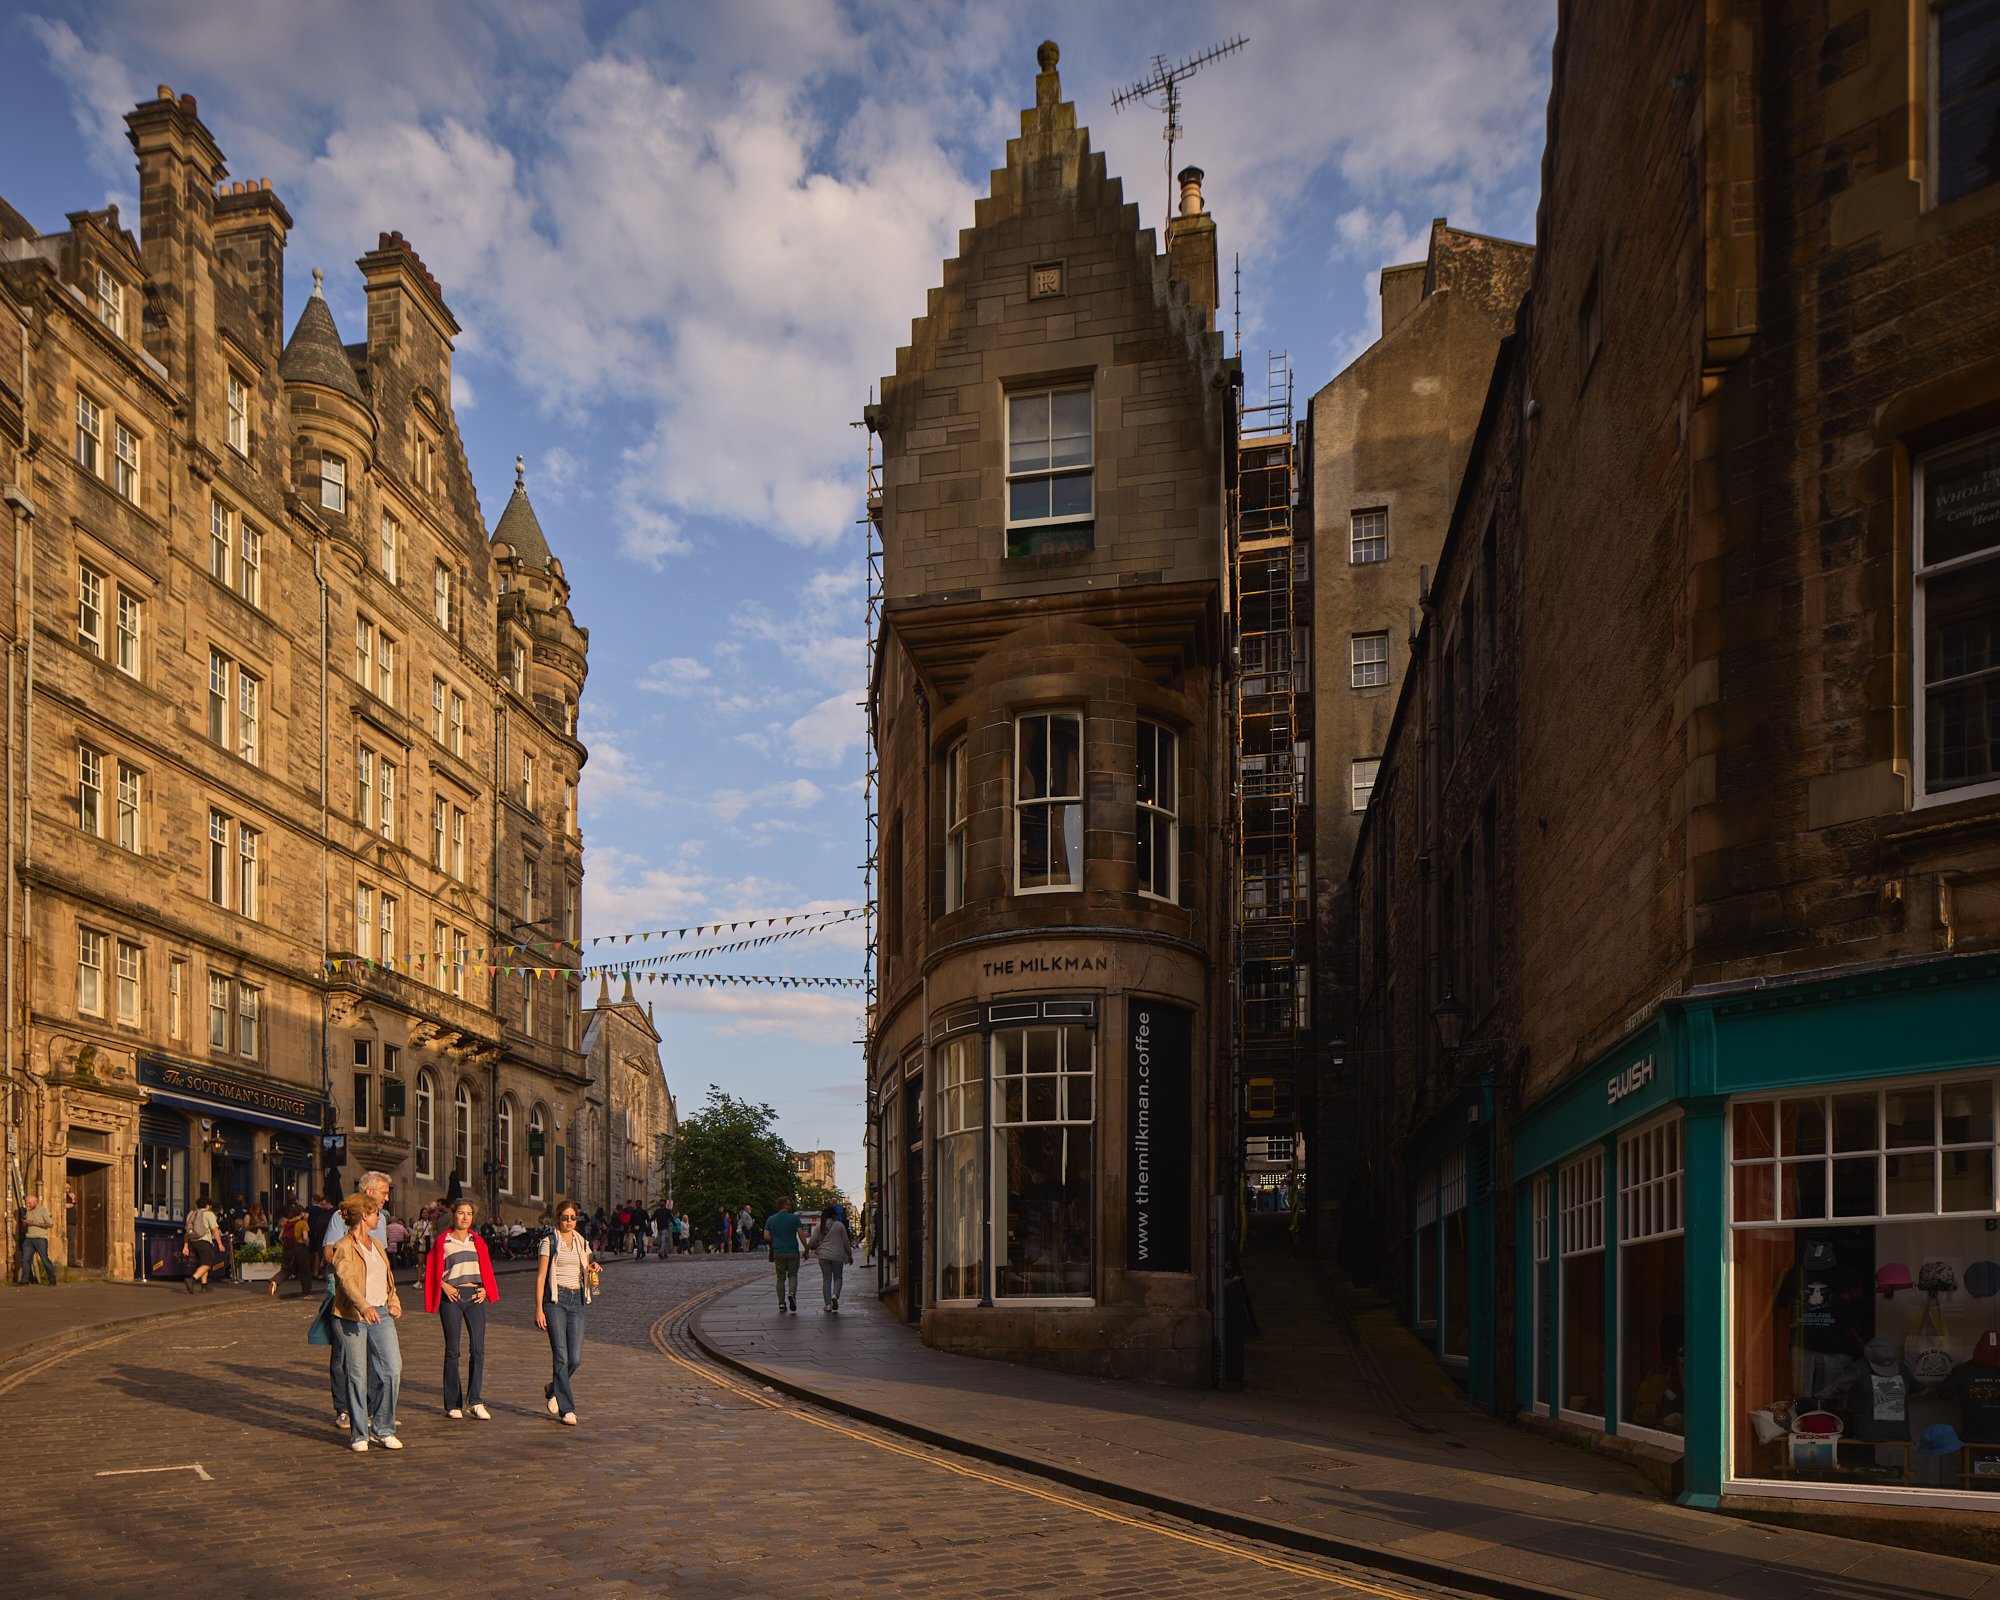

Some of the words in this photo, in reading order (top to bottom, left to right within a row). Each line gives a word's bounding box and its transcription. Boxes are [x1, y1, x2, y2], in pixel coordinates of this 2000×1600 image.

[1936, 480, 1991, 507] WHOLE
[983, 959, 1014, 977] THE
[1020, 956, 1107, 973] MILKMAN
[162, 1069, 185, 1087] The
[187, 1075, 260, 1105] SCOTSMAN'S
[262, 1094, 306, 1116] LOUNGE
[1607, 1053, 1654, 1105] SWISH
[1134, 1012, 1150, 1205] themilkman.coffee
